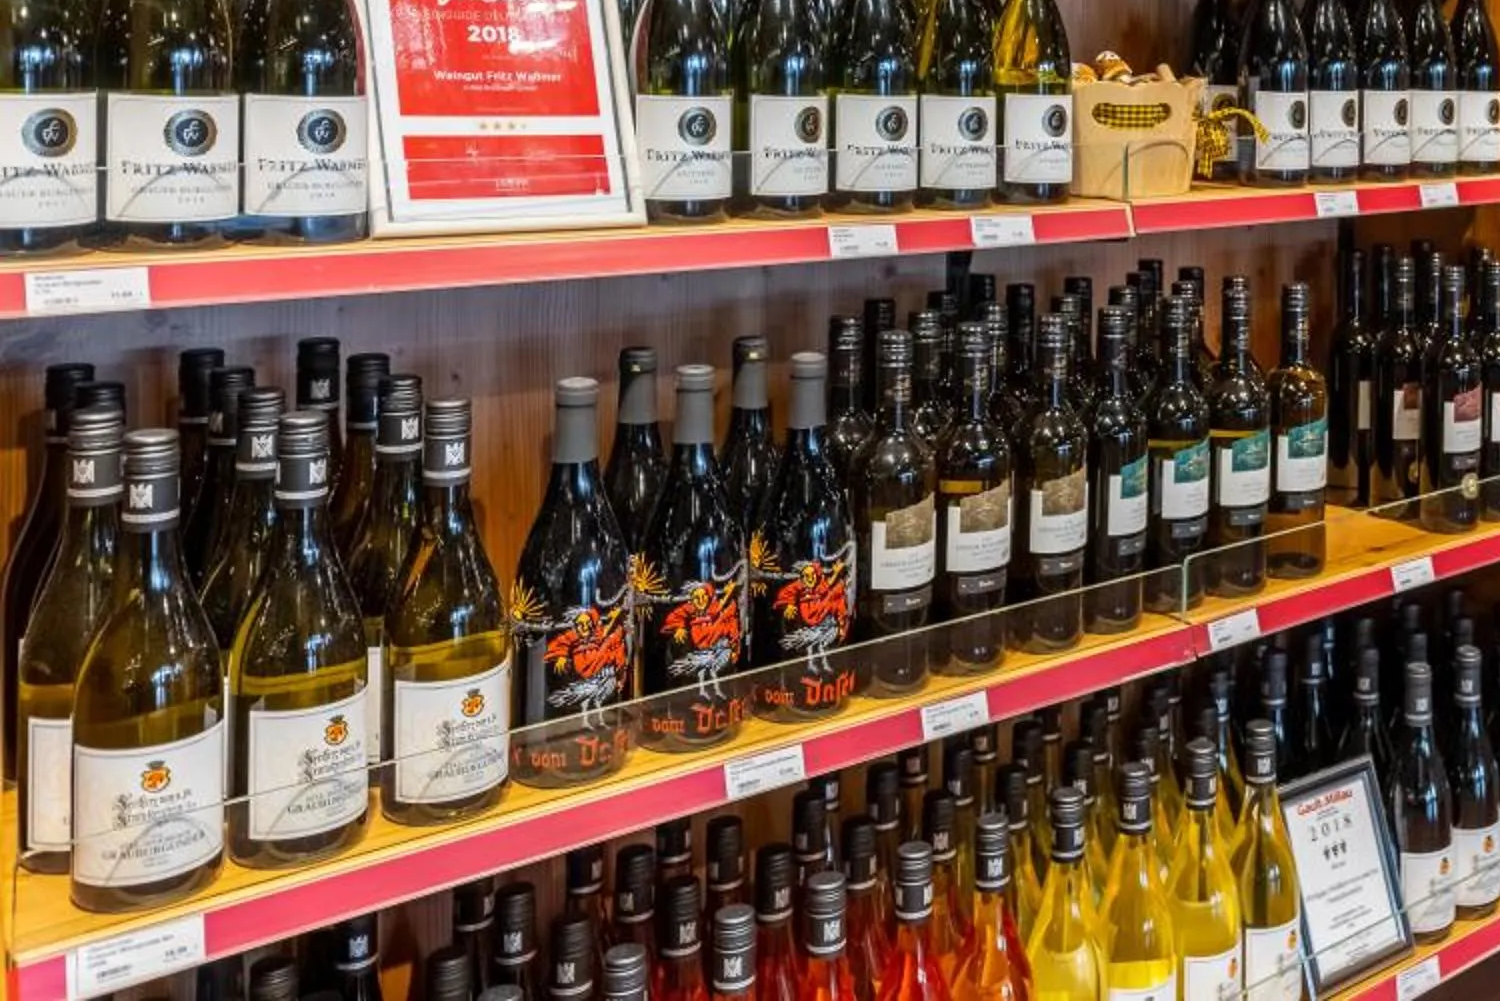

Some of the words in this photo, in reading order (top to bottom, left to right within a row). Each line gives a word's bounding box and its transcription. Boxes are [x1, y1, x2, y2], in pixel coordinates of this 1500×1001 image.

[467, 24, 522, 44] 2018
[433, 69, 484, 85] Weingut
[486, 70, 514, 82] Fritz
[1308, 813, 1354, 843] 2018
